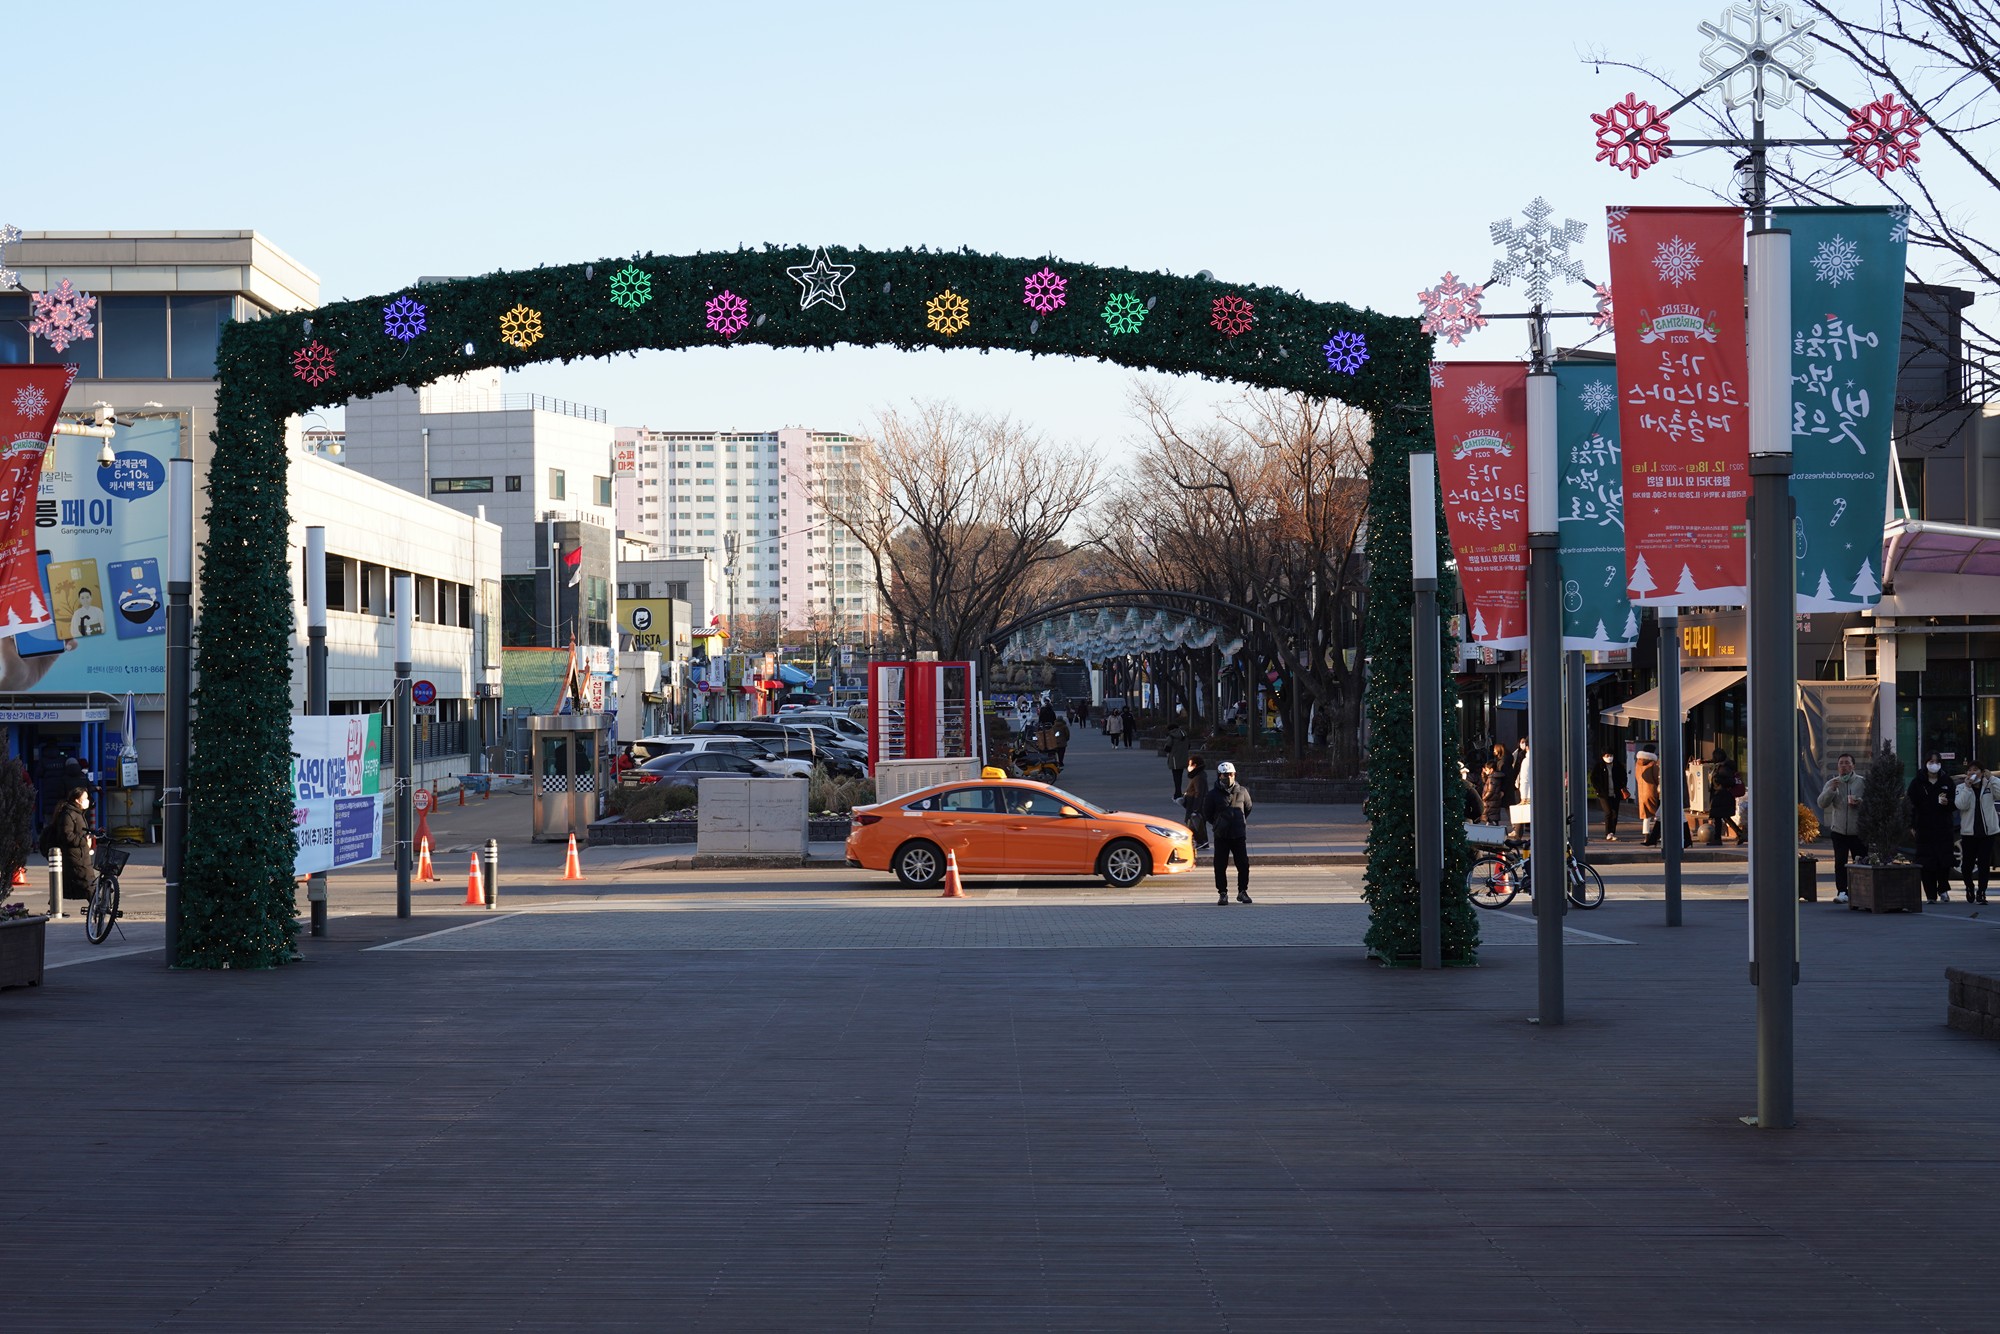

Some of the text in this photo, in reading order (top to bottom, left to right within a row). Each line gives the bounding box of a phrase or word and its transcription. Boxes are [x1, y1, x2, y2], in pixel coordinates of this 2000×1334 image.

[14, 431, 46, 440] MERRY
[618, 451, 634, 460] 슈퍼
[618, 461, 634, 470] 마켓
[45, 471, 73, 482] 살리는
[109, 480, 154, 491] 캐시백 적립
[60, 528, 99, 536] Gangneung
